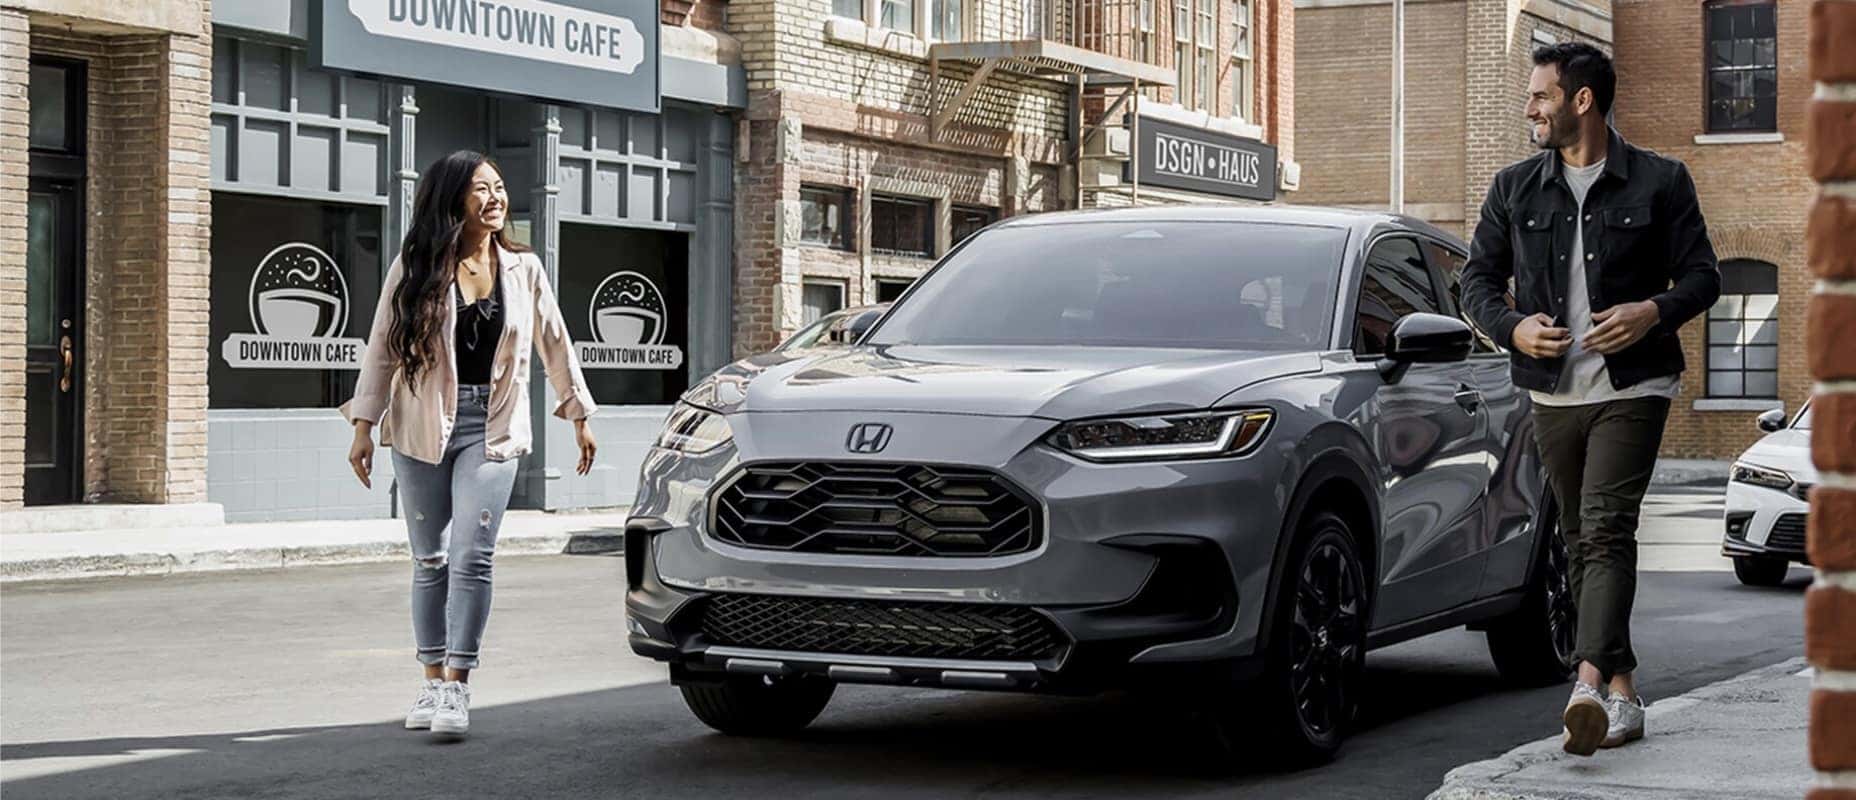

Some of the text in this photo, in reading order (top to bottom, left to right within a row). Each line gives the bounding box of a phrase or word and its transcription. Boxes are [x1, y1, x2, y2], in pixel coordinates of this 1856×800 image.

[389, 0, 621, 60] DOWNTOWN CAFE
[1156, 138, 1259, 184] DSGN HAUS
[240, 341, 357, 363] DOWNTOWN CAFE
[582, 347, 673, 364] DOWNTOWN CAFE
